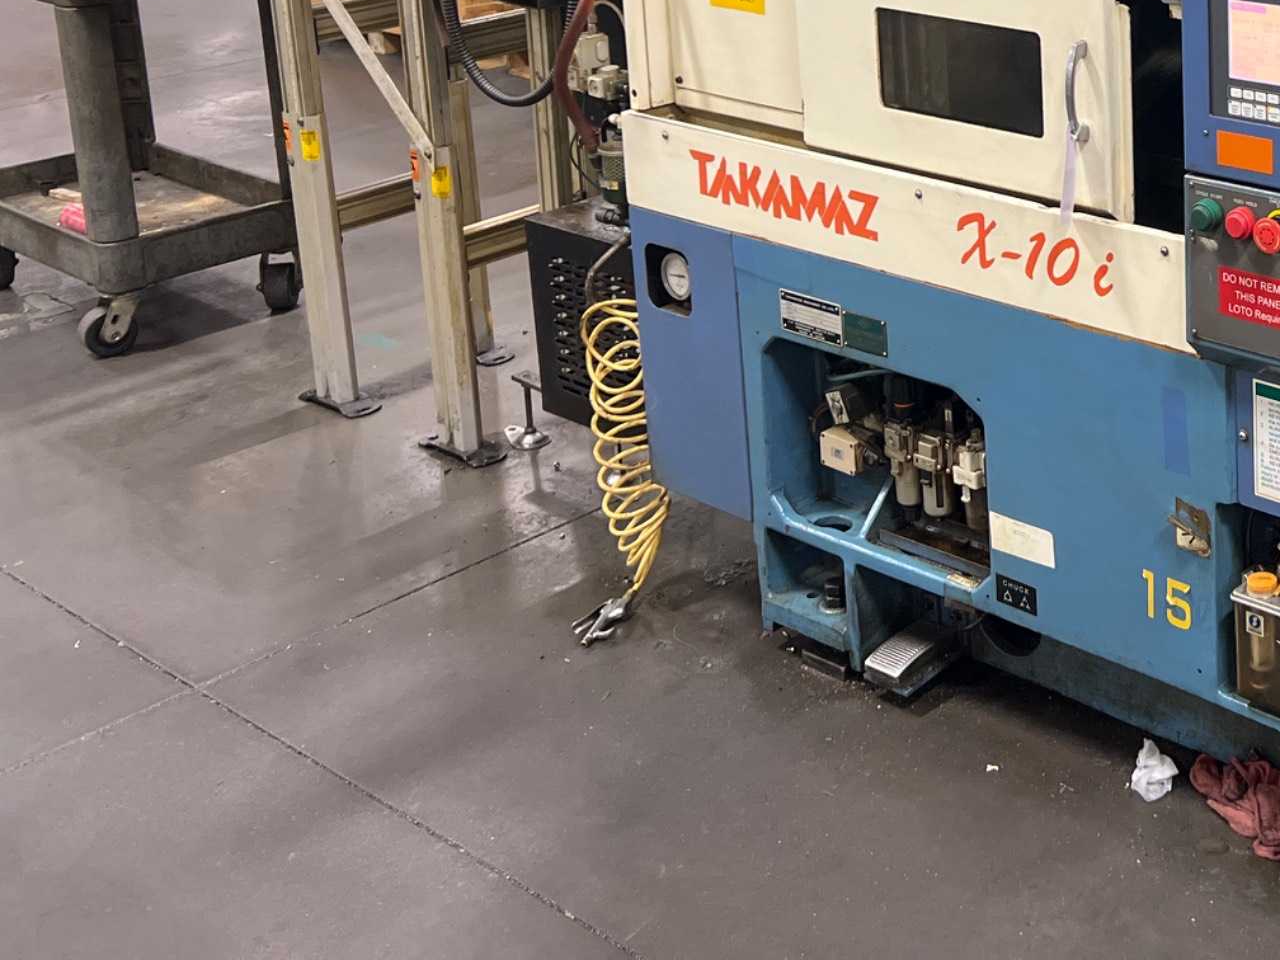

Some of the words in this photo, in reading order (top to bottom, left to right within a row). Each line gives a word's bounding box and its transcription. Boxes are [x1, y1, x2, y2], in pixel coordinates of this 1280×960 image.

[689, 149, 879, 242] TAKAMAZ
[1222, 272, 1237, 284] DO
[1238, 276, 1259, 289] NOT
[1234, 290, 1256, 304] THIS
[1228, 303, 1253, 318] LOTO
[1142, 568, 1193, 631] 15
